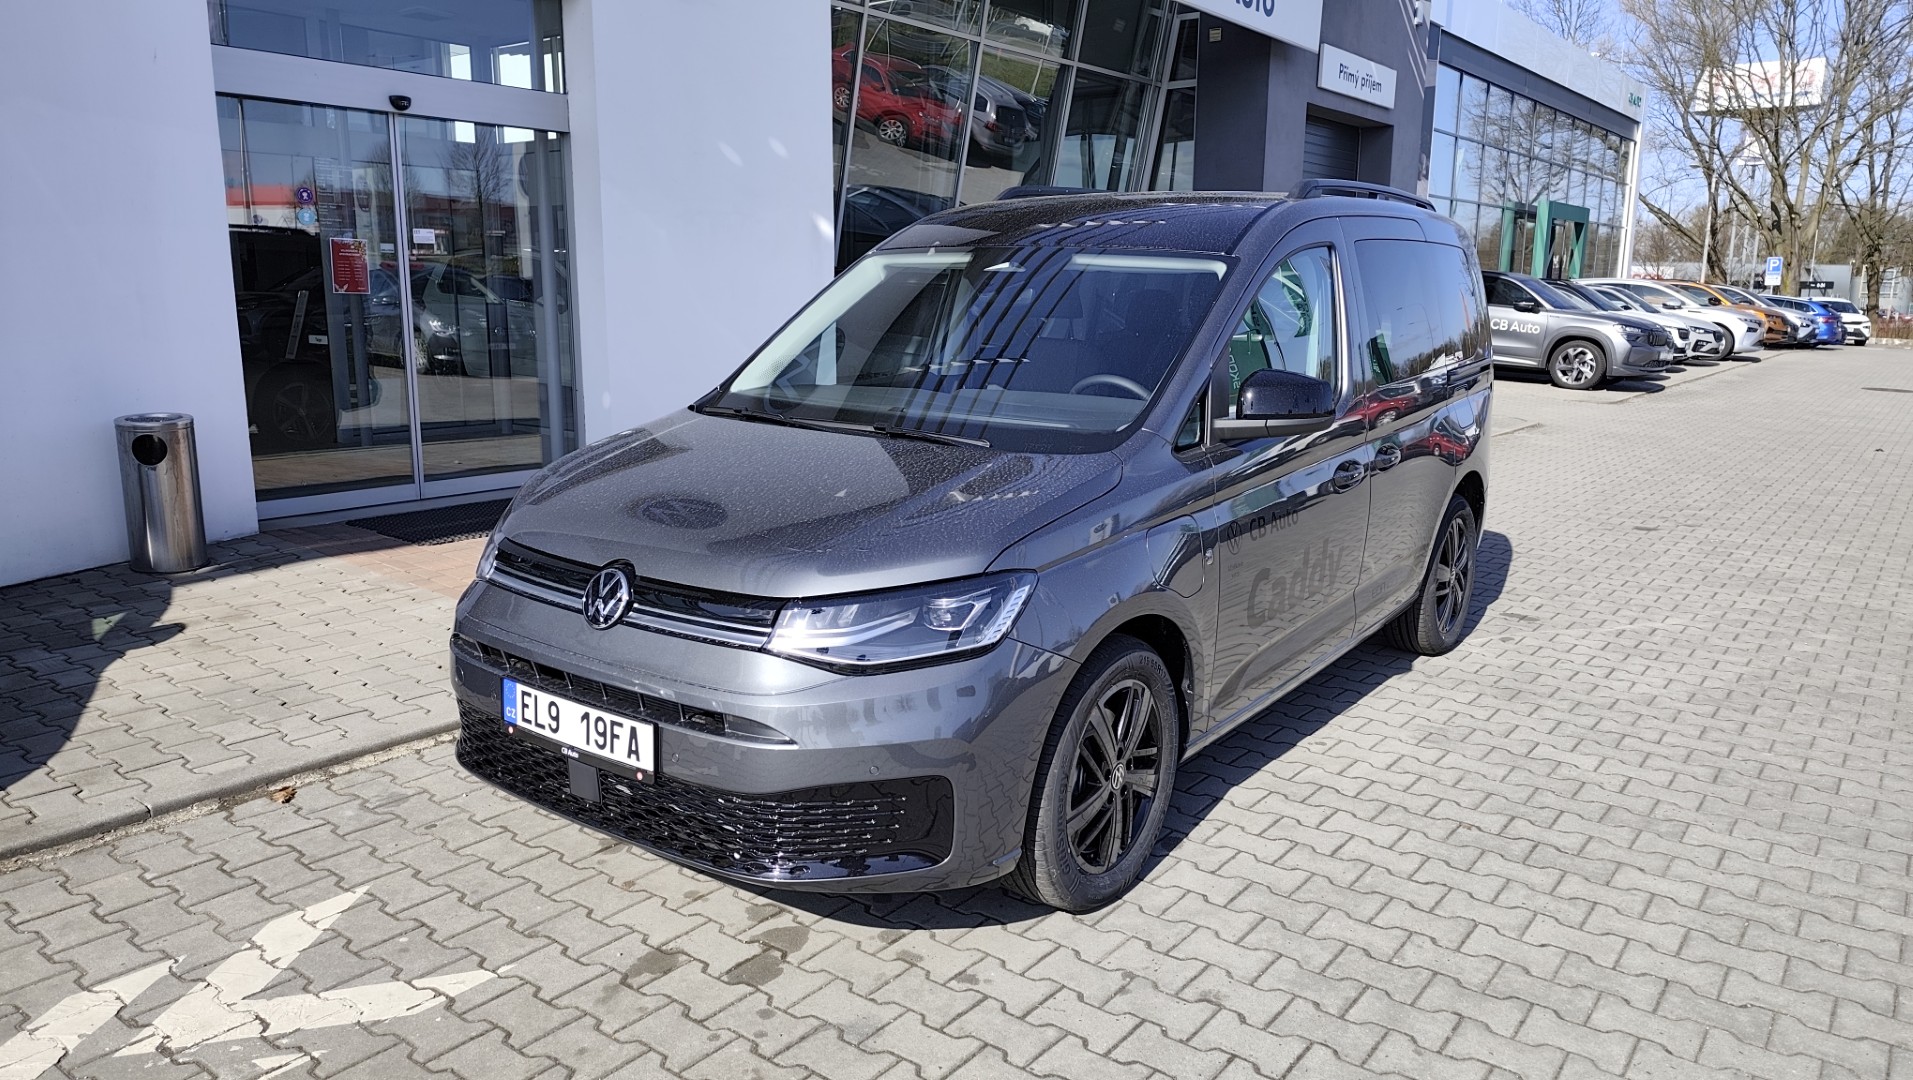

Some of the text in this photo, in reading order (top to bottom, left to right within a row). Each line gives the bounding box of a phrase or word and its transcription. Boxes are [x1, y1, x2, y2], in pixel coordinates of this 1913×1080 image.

[1769, 259, 1780, 271] P
[1490, 318, 1541, 335] CB Auto
[1249, 515, 1267, 542] CB
[1269, 508, 1299, 534] Auto
[1247, 537, 1344, 629] Caddy
[506, 690, 641, 762] CZ EL9 19FA
